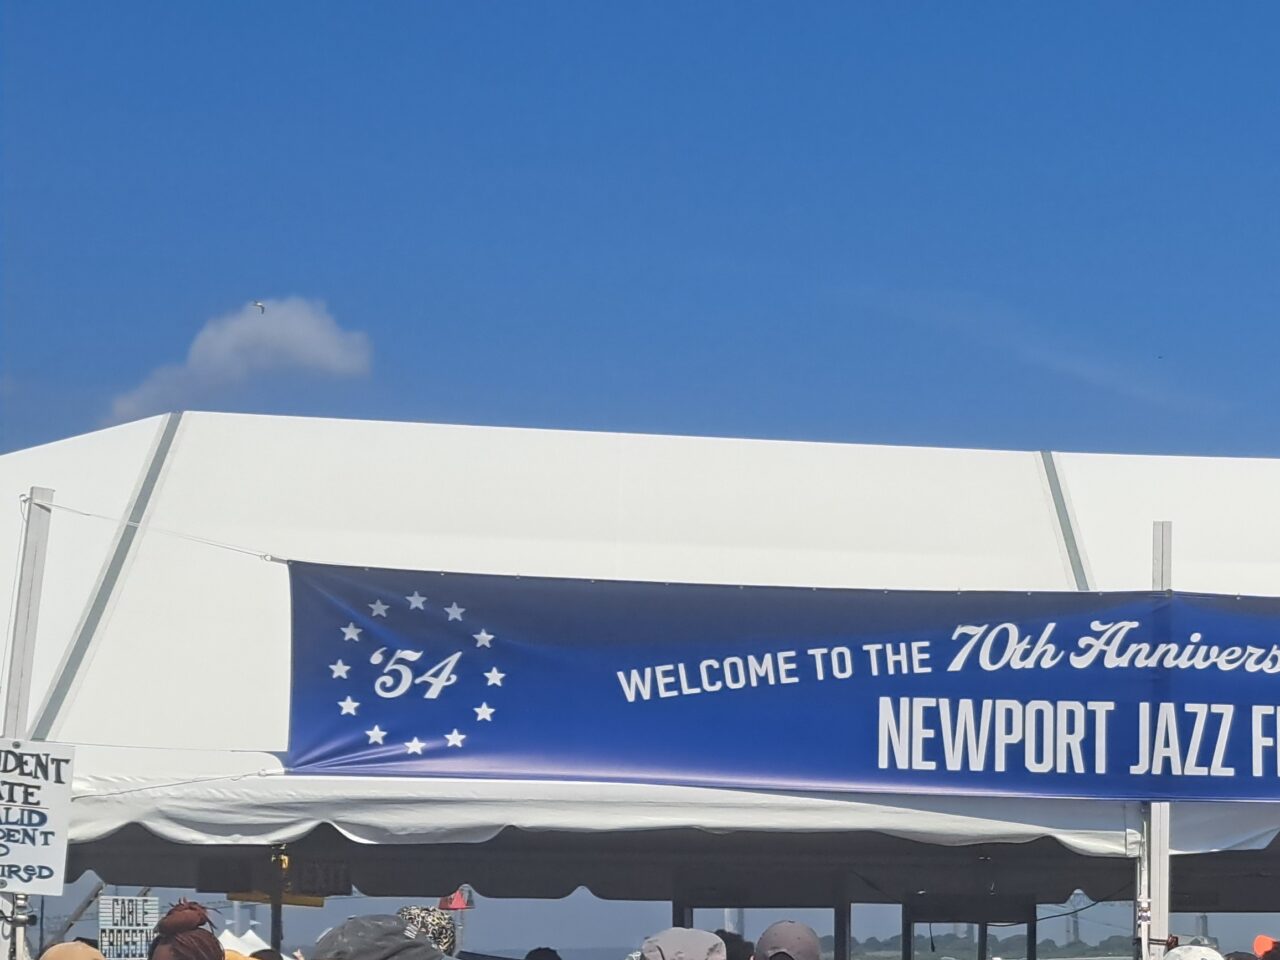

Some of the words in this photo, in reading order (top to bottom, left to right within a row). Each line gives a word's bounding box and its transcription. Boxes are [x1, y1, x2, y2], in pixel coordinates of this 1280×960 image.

[617, 651, 799, 703] WELCOME
[808, 647, 853, 680] TO
[863, 641, 931, 676] THE
[947, 622, 1065, 672] 70th
[878, 696, 1115, 775] NEWPORT
[1129, 701, 1235, 777] JAZZ
[0, 780, 42, 806] TE
[0, 807, 48, 828] LID
[112, 898, 149, 927] CABLE
[101, 929, 158, 958] CROSSIN
